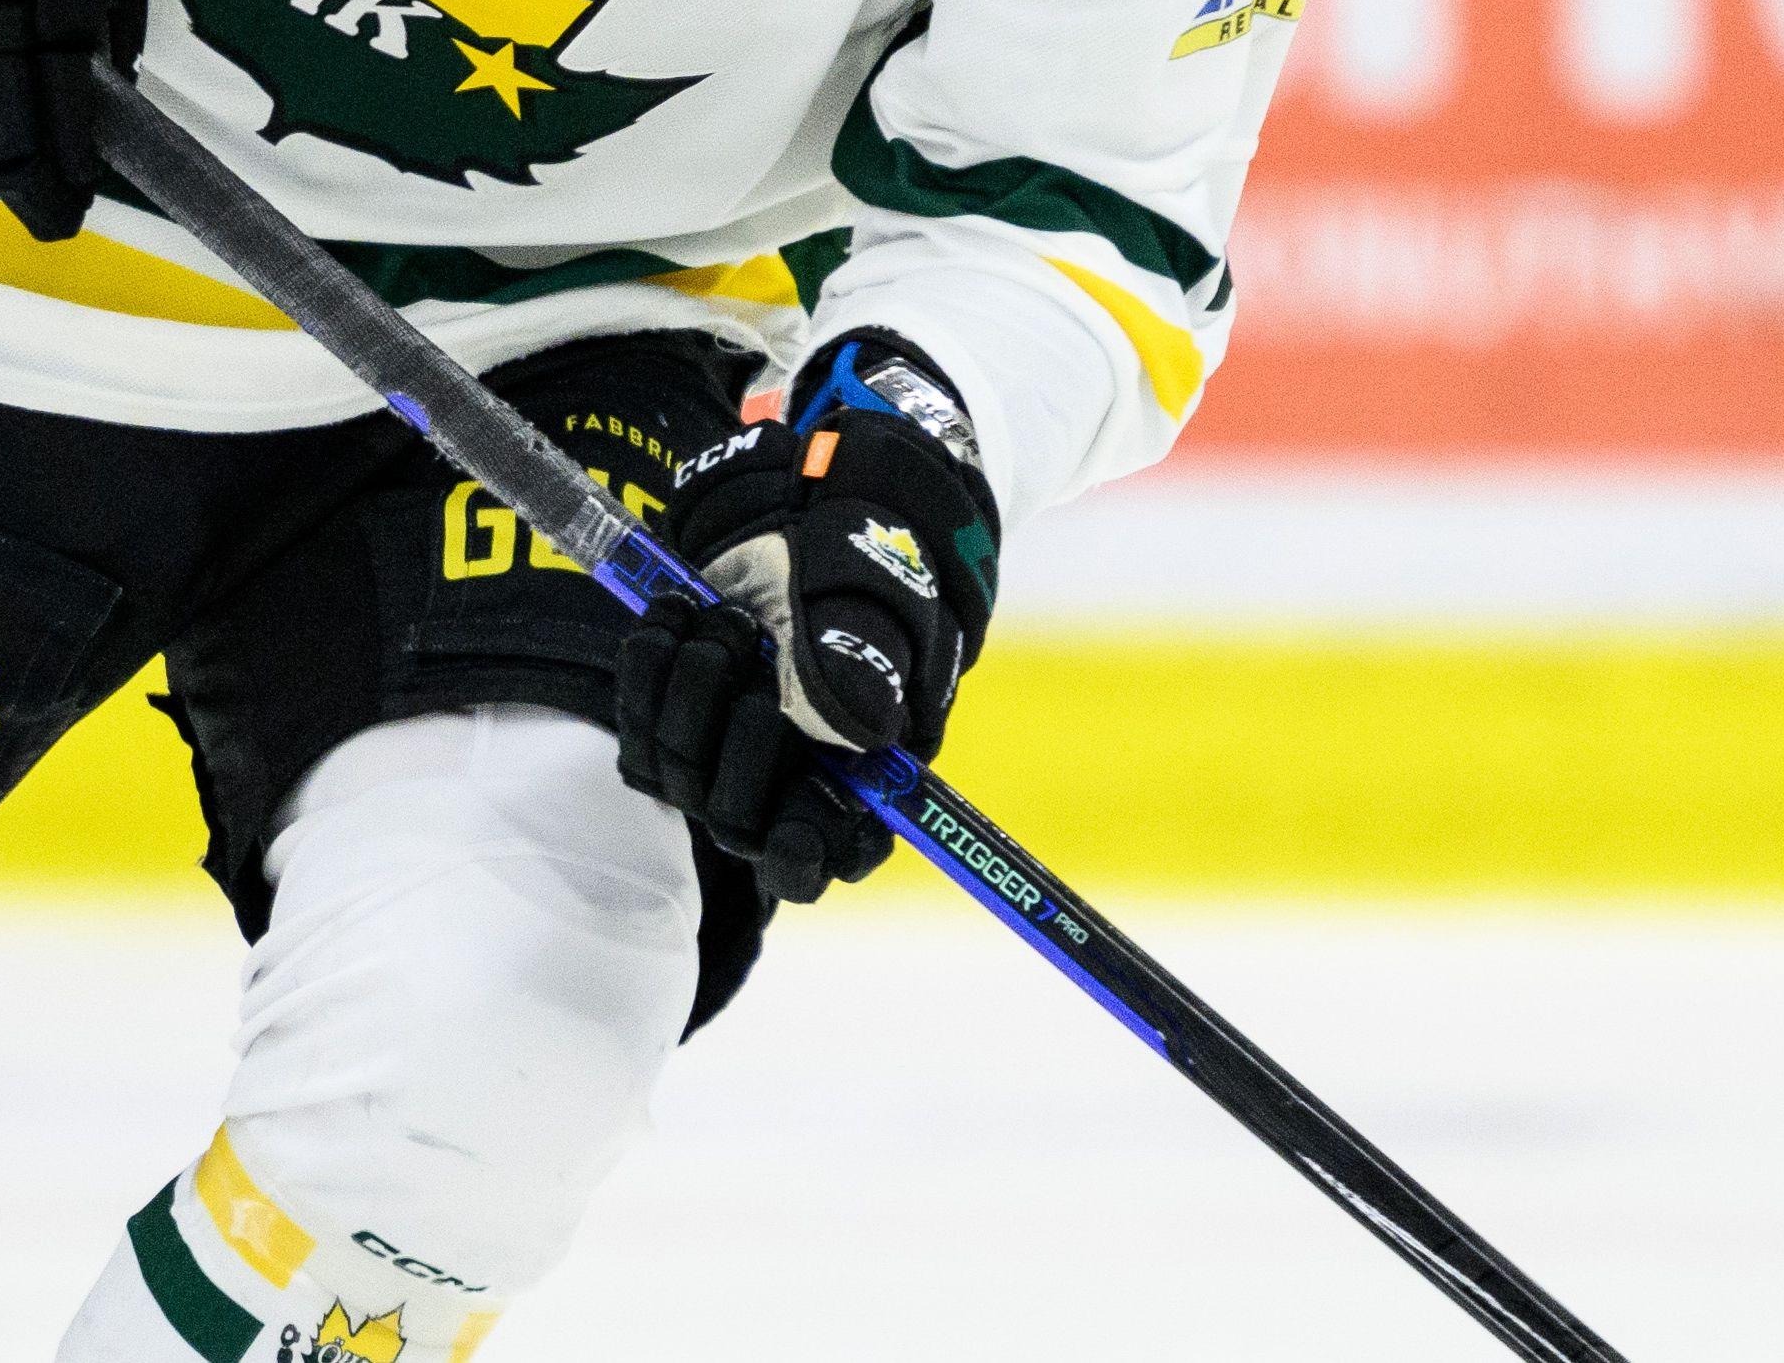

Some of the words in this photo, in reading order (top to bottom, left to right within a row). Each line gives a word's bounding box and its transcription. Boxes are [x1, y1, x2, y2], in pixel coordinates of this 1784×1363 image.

[566, 413, 681, 472] FABBRI
[675, 427, 763, 488] CCM
[920, 798, 1042, 911] TRIGGER
[1054, 912, 1089, 944] PRO
